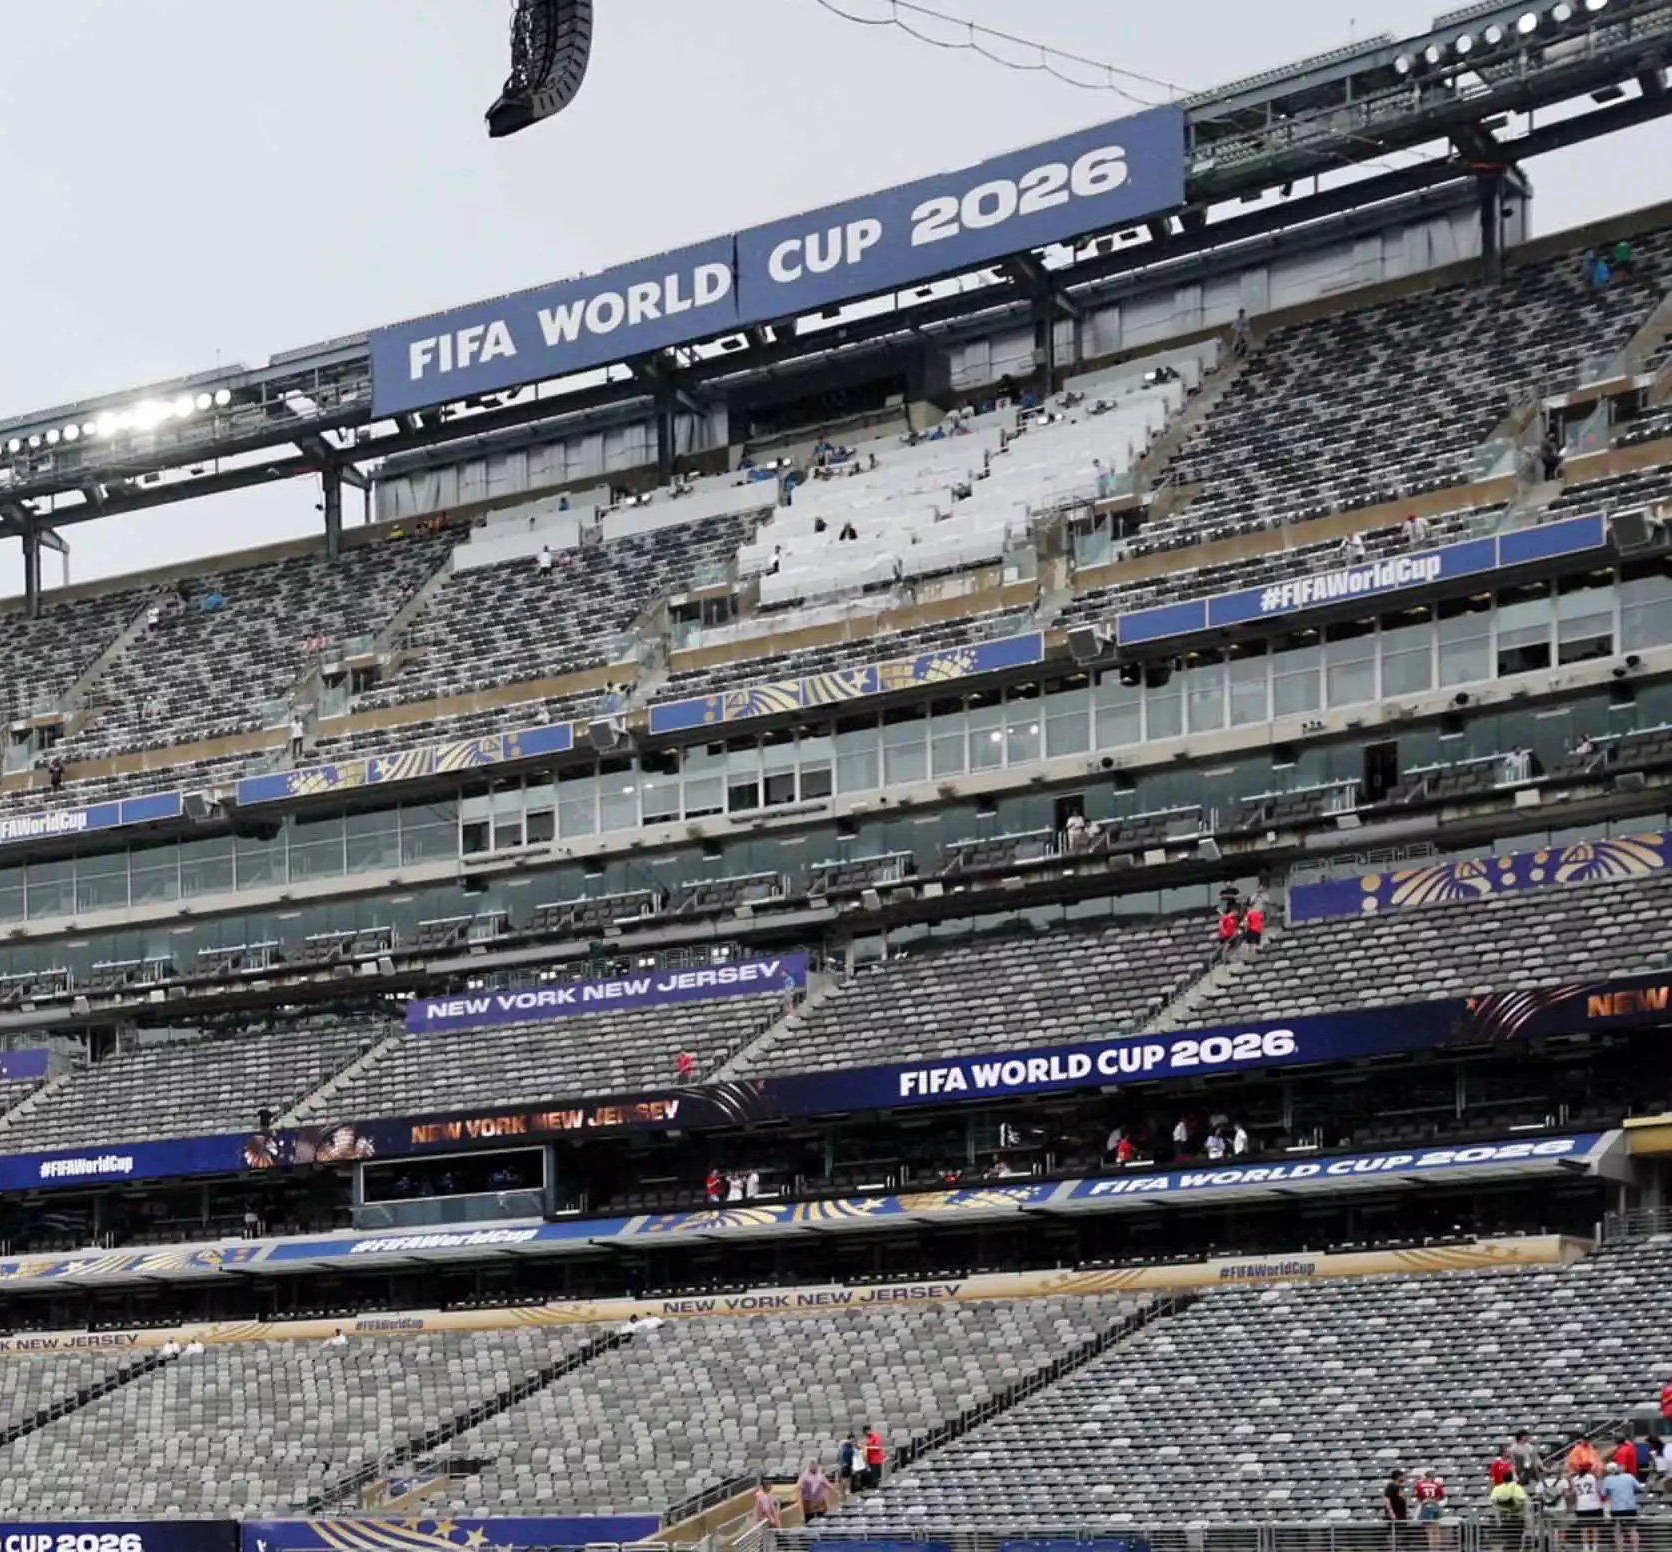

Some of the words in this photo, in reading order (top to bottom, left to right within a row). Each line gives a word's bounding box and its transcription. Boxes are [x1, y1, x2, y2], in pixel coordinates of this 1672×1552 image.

[409, 320, 517, 380] FIFA
[537, 263, 732, 347] WORLD
[768, 218, 882, 282] CUP
[911, 145, 1129, 246] 2026
[1260, 555, 1441, 611] #FIFAWorldCup
[427, 998, 491, 1019] NEW
[497, 988, 576, 1011] YORK
[583, 979, 651, 1000] NEW
[657, 961, 780, 992] JERSEY
[1587, 987, 1669, 1017] NEW
[900, 1067, 967, 1096] FIFA
[971, 1051, 1092, 1089] WORLD
[1097, 1045, 1165, 1074] CUP
[1170, 1030, 1295, 1067] 2026
[411, 1121, 461, 1143] NEW
[466, 1116, 527, 1137] YORK
[41, 1155, 133, 1179] #FIFAWorldCup
[1090, 1177, 1169, 1195] FIFA
[1179, 1163, 1321, 1188] WORLD
[1326, 1154, 1413, 1176] CUP
[1415, 1140, 1575, 1166] 2026
[350, 1229, 540, 1253] #FIFAWorldCup
[1220, 1261, 1315, 1279] #FIFAWorldCup
[662, 1301, 716, 1314] NEW
[725, 1295, 790, 1311] YORK
[797, 1291, 853, 1307] NEW
[859, 1284, 961, 1303] JERSEY
[16, 1337, 59, 1350] NEW
[63, 1333, 139, 1348] JERSEY
